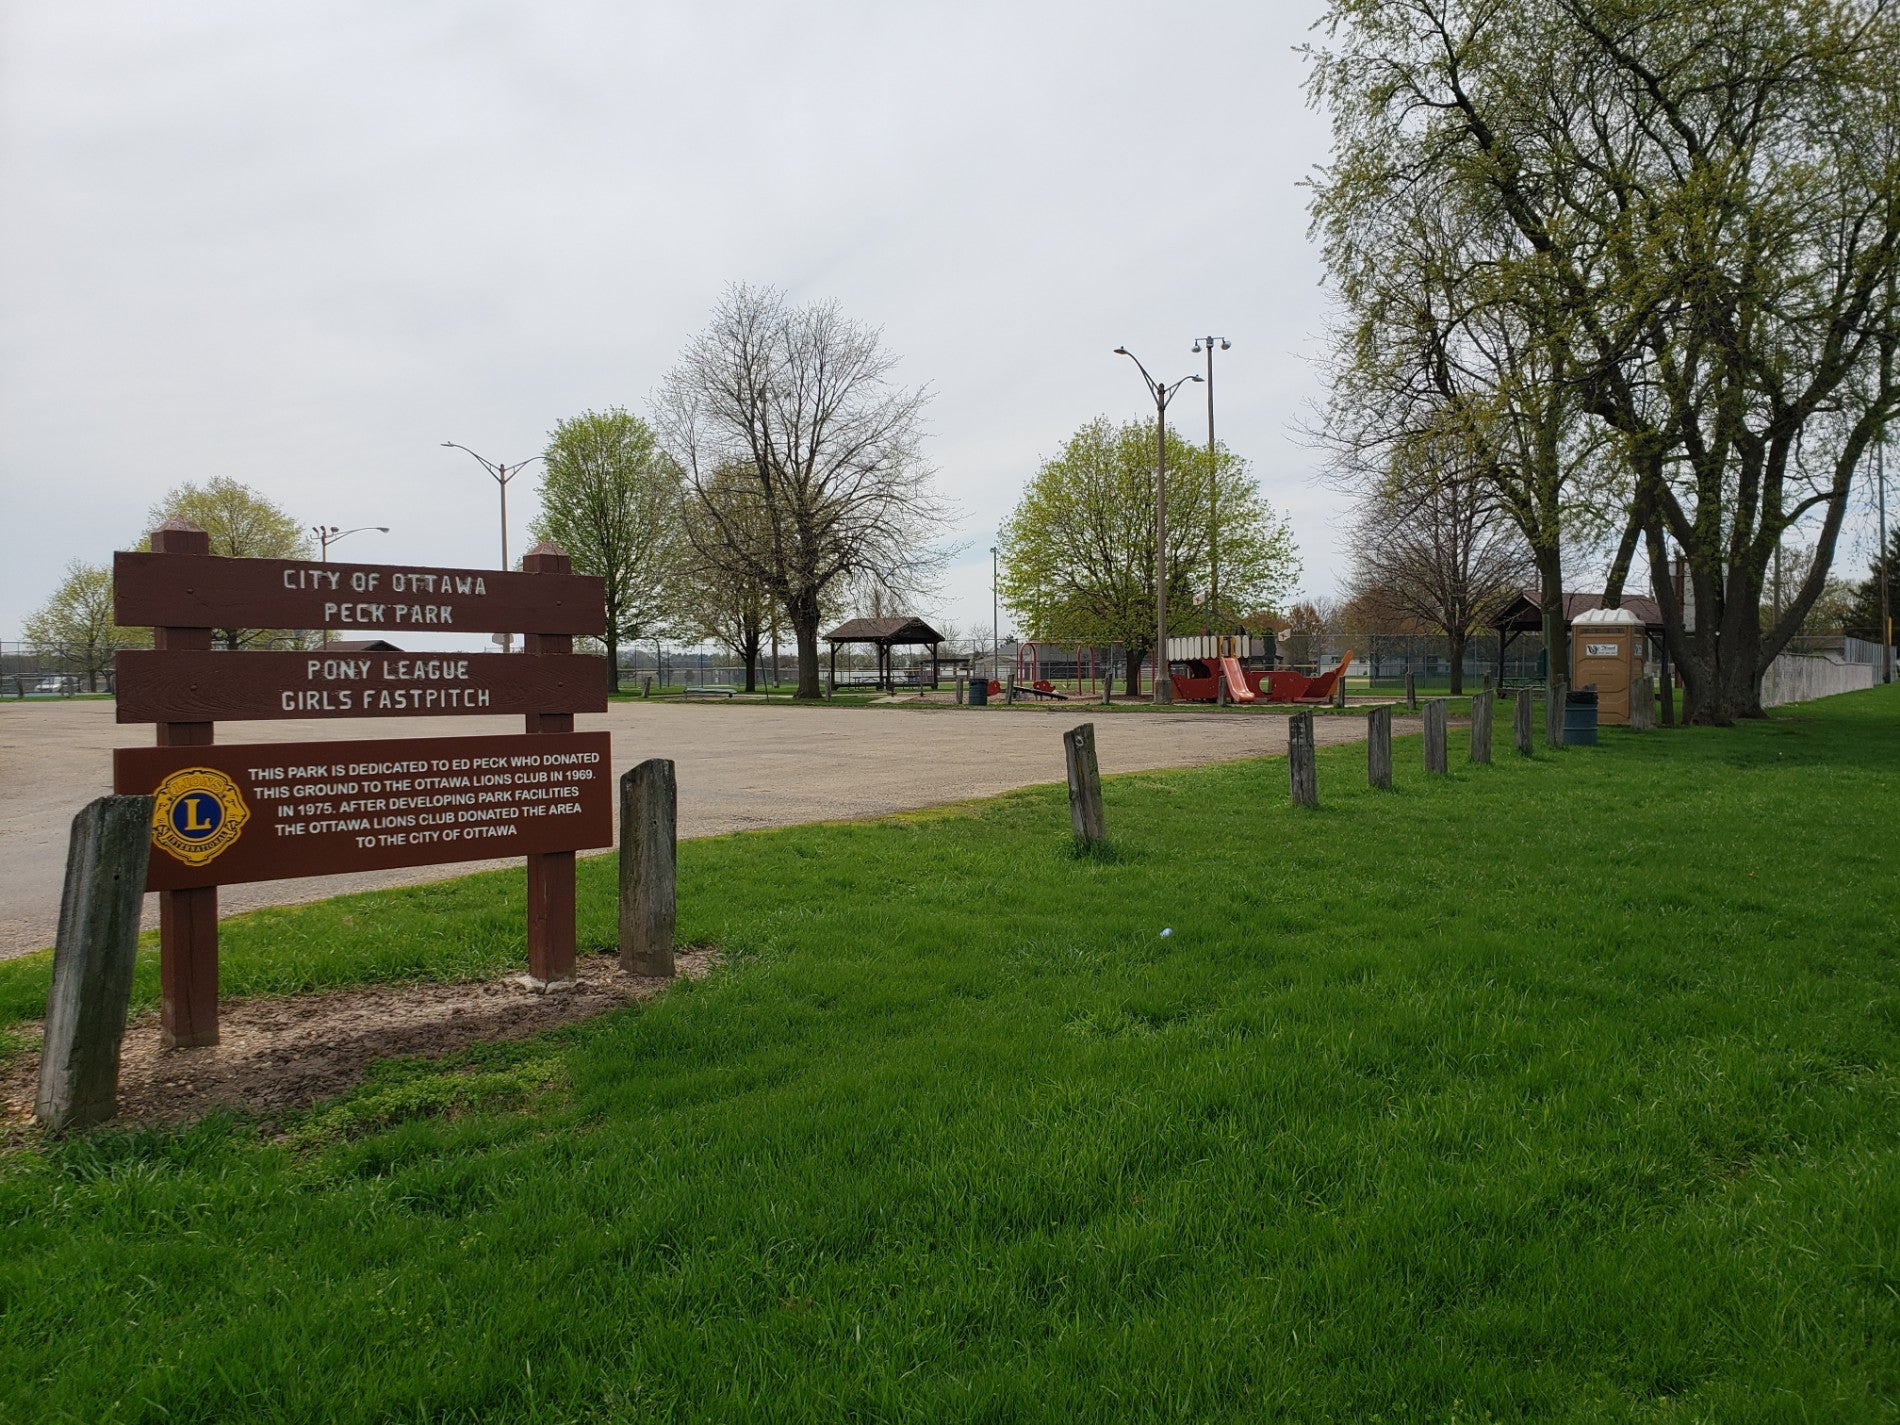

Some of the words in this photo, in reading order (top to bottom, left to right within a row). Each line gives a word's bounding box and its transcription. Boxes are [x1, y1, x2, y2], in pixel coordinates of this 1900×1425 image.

[284, 570, 340, 590] CITY
[352, 572, 380, 592] OF
[393, 573, 486, 595] OTTAWA
[325, 603, 384, 623] PECK
[396, 605, 453, 624] PARK
[308, 660, 371, 680] PONY
[384, 660, 468, 680] LEAGUE
[282, 690, 352, 710] GIRLS
[364, 689, 490, 709] FASTPITCH
[248, 767, 284, 780] THIS
[288, 765, 328, 779] PARK
[332, 765, 345, 777] IS
[349, 761, 428, 776] DEDICATED
[431, 760, 449, 771] TO
[452, 759, 470, 770] ED
[473, 757, 508, 769] PECK
[510, 755, 540, 767] WHO
[543, 752, 600, 766] DONATED
[172, 776, 224, 792] LIONS
[254, 786, 290, 799] THIS
[293, 783, 358, 797] GROUND
[361, 781, 381, 793] TO
[383, 779, 411, 792] THE
[414, 777, 470, 790] OTTAWA
[473, 774, 512, 787] LIONS
[514, 772, 548, 784] CLUB
[550, 770, 563, 782] IN
[566, 769, 596, 781] 1969.
[278, 805, 294, 817] IN
[298, 803, 336, 816] 1975.
[340, 799, 386, 813] AFTER
[389, 794, 475, 810] DEVELOPING
[478, 791, 512, 803] PARK
[515, 787, 579, 801] FACILITIES
[184, 798, 213, 831] L
[275, 823, 306, 836] THE
[309, 819, 370, 834] OTTAWA
[373, 815, 416, 829] LIONS
[418, 812, 455, 825] CLUB
[458, 807, 519, 822] DONATED
[522, 805, 546, 817] THE
[549, 803, 582, 815] AREA
[167, 831, 228, 852] INTERNATIONAL
[356, 836, 376, 848] TO
[378, 834, 406, 847] THE
[409, 831, 440, 845] CITY
[442, 830, 460, 841] OF
[463, 825, 517, 840] OTTAWA
